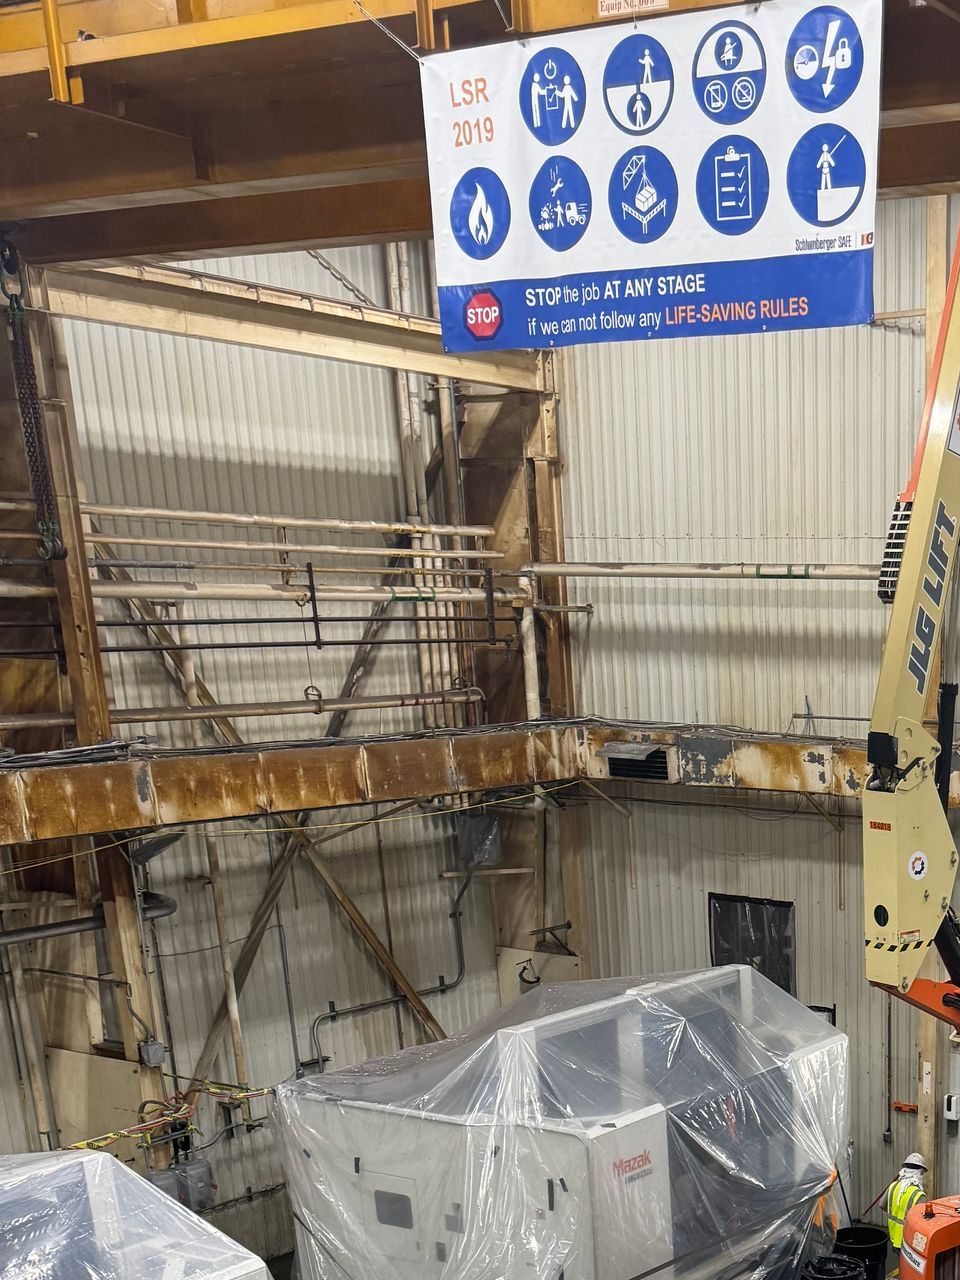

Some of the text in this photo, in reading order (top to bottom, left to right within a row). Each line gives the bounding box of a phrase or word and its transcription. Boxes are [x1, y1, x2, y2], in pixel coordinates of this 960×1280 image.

[449, 77, 490, 108] LSR
[453, 116, 494, 148] 2019
[795, 233, 837, 251] Schlumberger
[838, 235, 852, 248] SAFE
[525, 273, 706, 307] STOP the job AT ANY STAGE
[466, 306, 500, 325] STOP
[527, 296, 809, 336] if we can not follow any LIFE-SAVING RULES
[906, 497, 956, 697] JLG LIFT
[612, 1149, 652, 1178] Mazak
